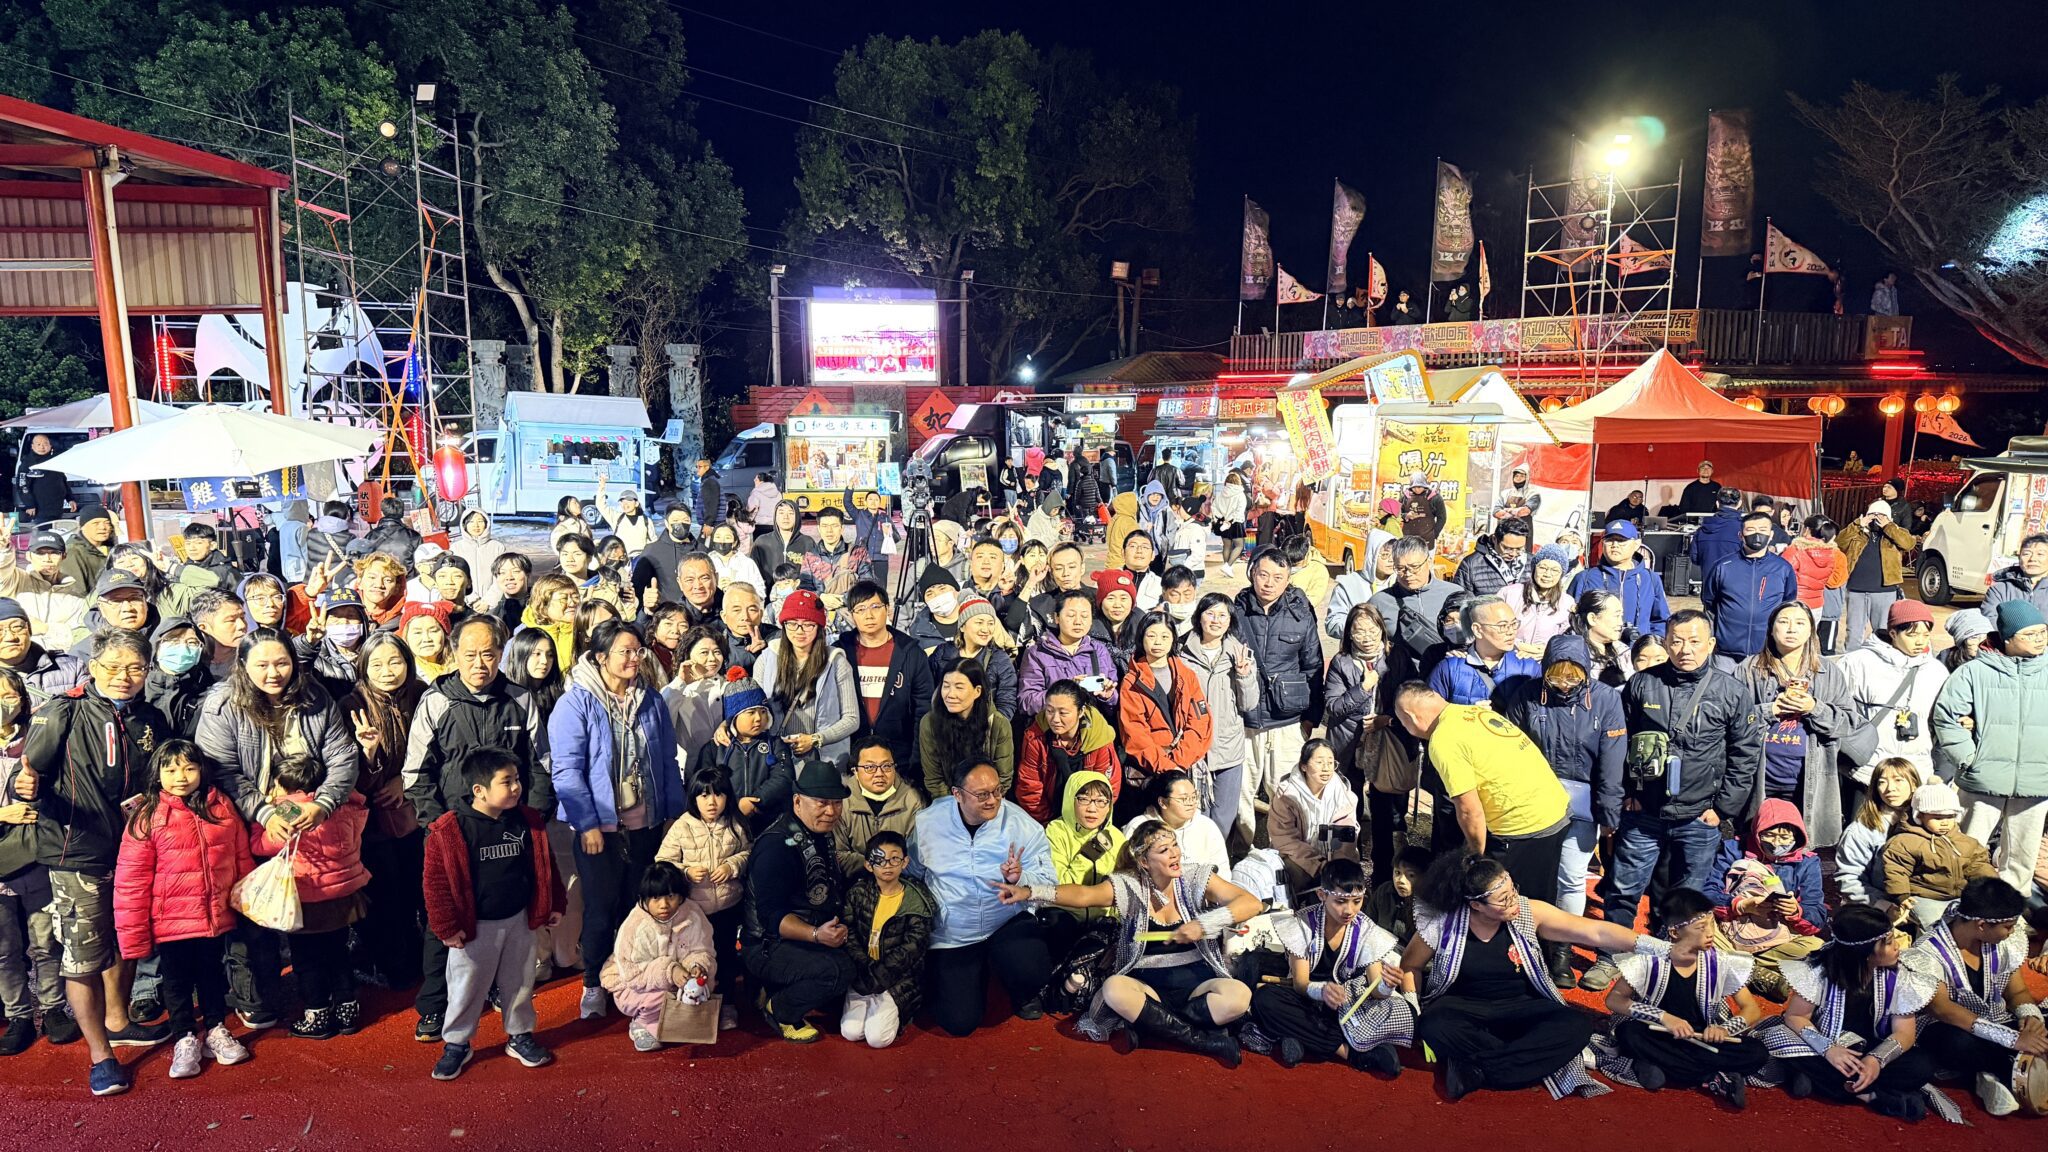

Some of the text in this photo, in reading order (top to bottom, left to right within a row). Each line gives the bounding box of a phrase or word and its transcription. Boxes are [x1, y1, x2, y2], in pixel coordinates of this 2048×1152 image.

[1230, 401, 1266, 415] 地瓜球
[1948, 431, 1968, 442] 2026
[1398, 449, 1447, 478] 爆汁
[480, 842, 520, 861] PUMA
